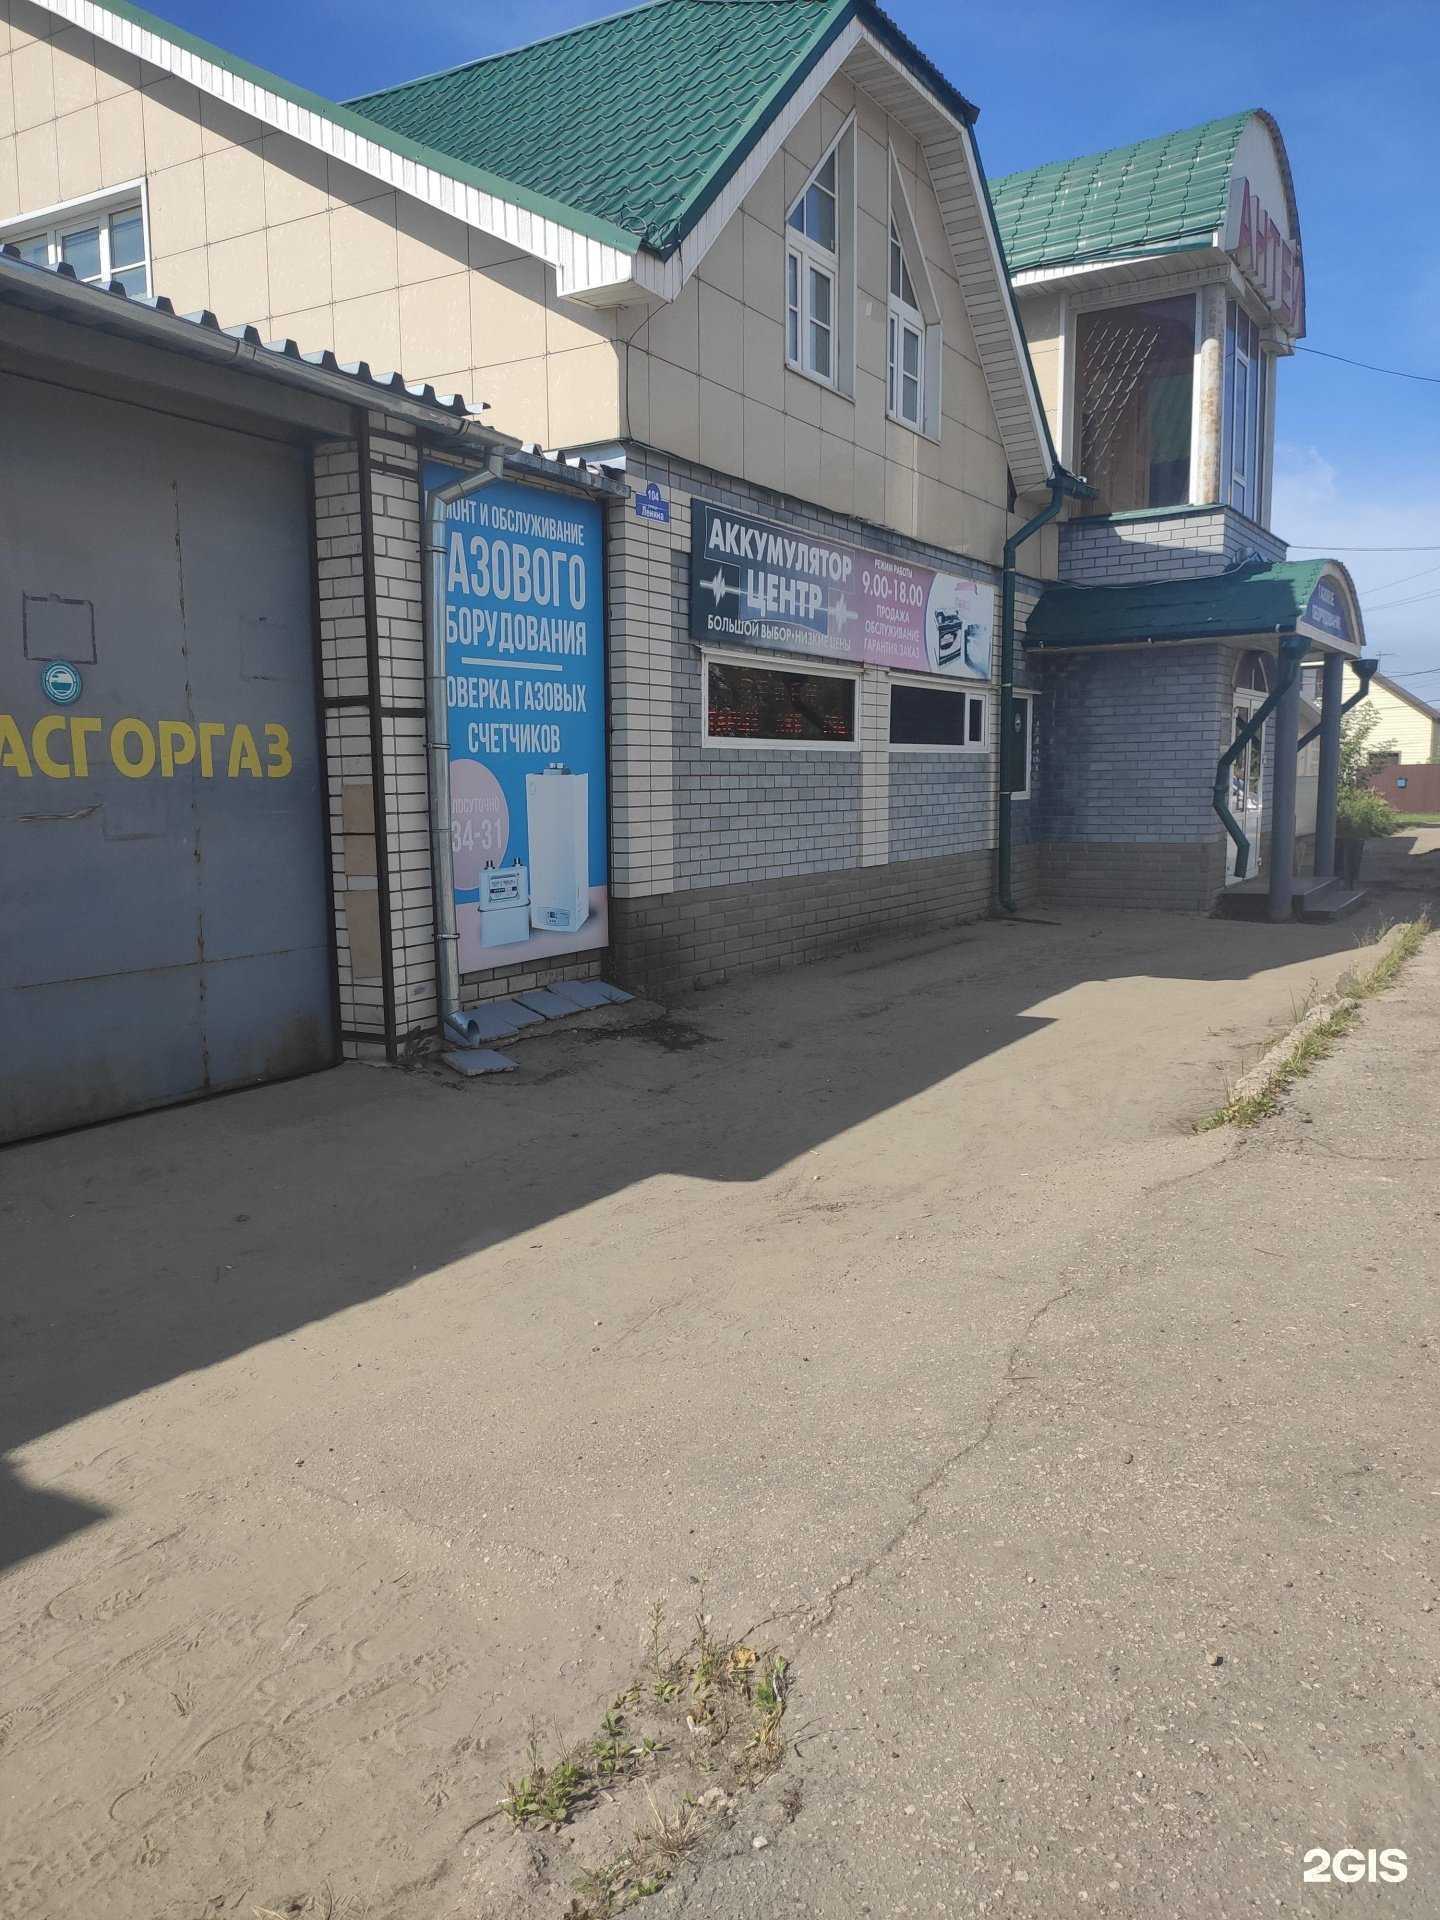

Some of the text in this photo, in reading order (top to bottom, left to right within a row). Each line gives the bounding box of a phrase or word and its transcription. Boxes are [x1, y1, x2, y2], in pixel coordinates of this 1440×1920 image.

[480, 503, 489, 528] И
[491, 505, 585, 546] ОБСЛУЖИВАНИЕ
[641, 505, 664, 521] Ленина
[708, 518, 852, 583] АККУМУЛЯТОР
[447, 531, 586, 611] АЗОВОГО
[862, 570, 923, 608] 9.00-18.00
[747, 568, 823, 619] ЦЕНТР
[445, 604, 587, 656] БОРУДОВАНИЯ
[707, 614, 760, 637] БОЛЬШОЙ
[761, 623, 792, 642] ВЫБОР
[876, 604, 910, 625] ПРОДАЖА
[446, 675, 587, 713] ОВЕРКА ГАЗОВЫХ
[0, 714, 293, 779] АСГОРГАЗ
[468, 722, 561, 753] СЧЕТЧИКОВ
